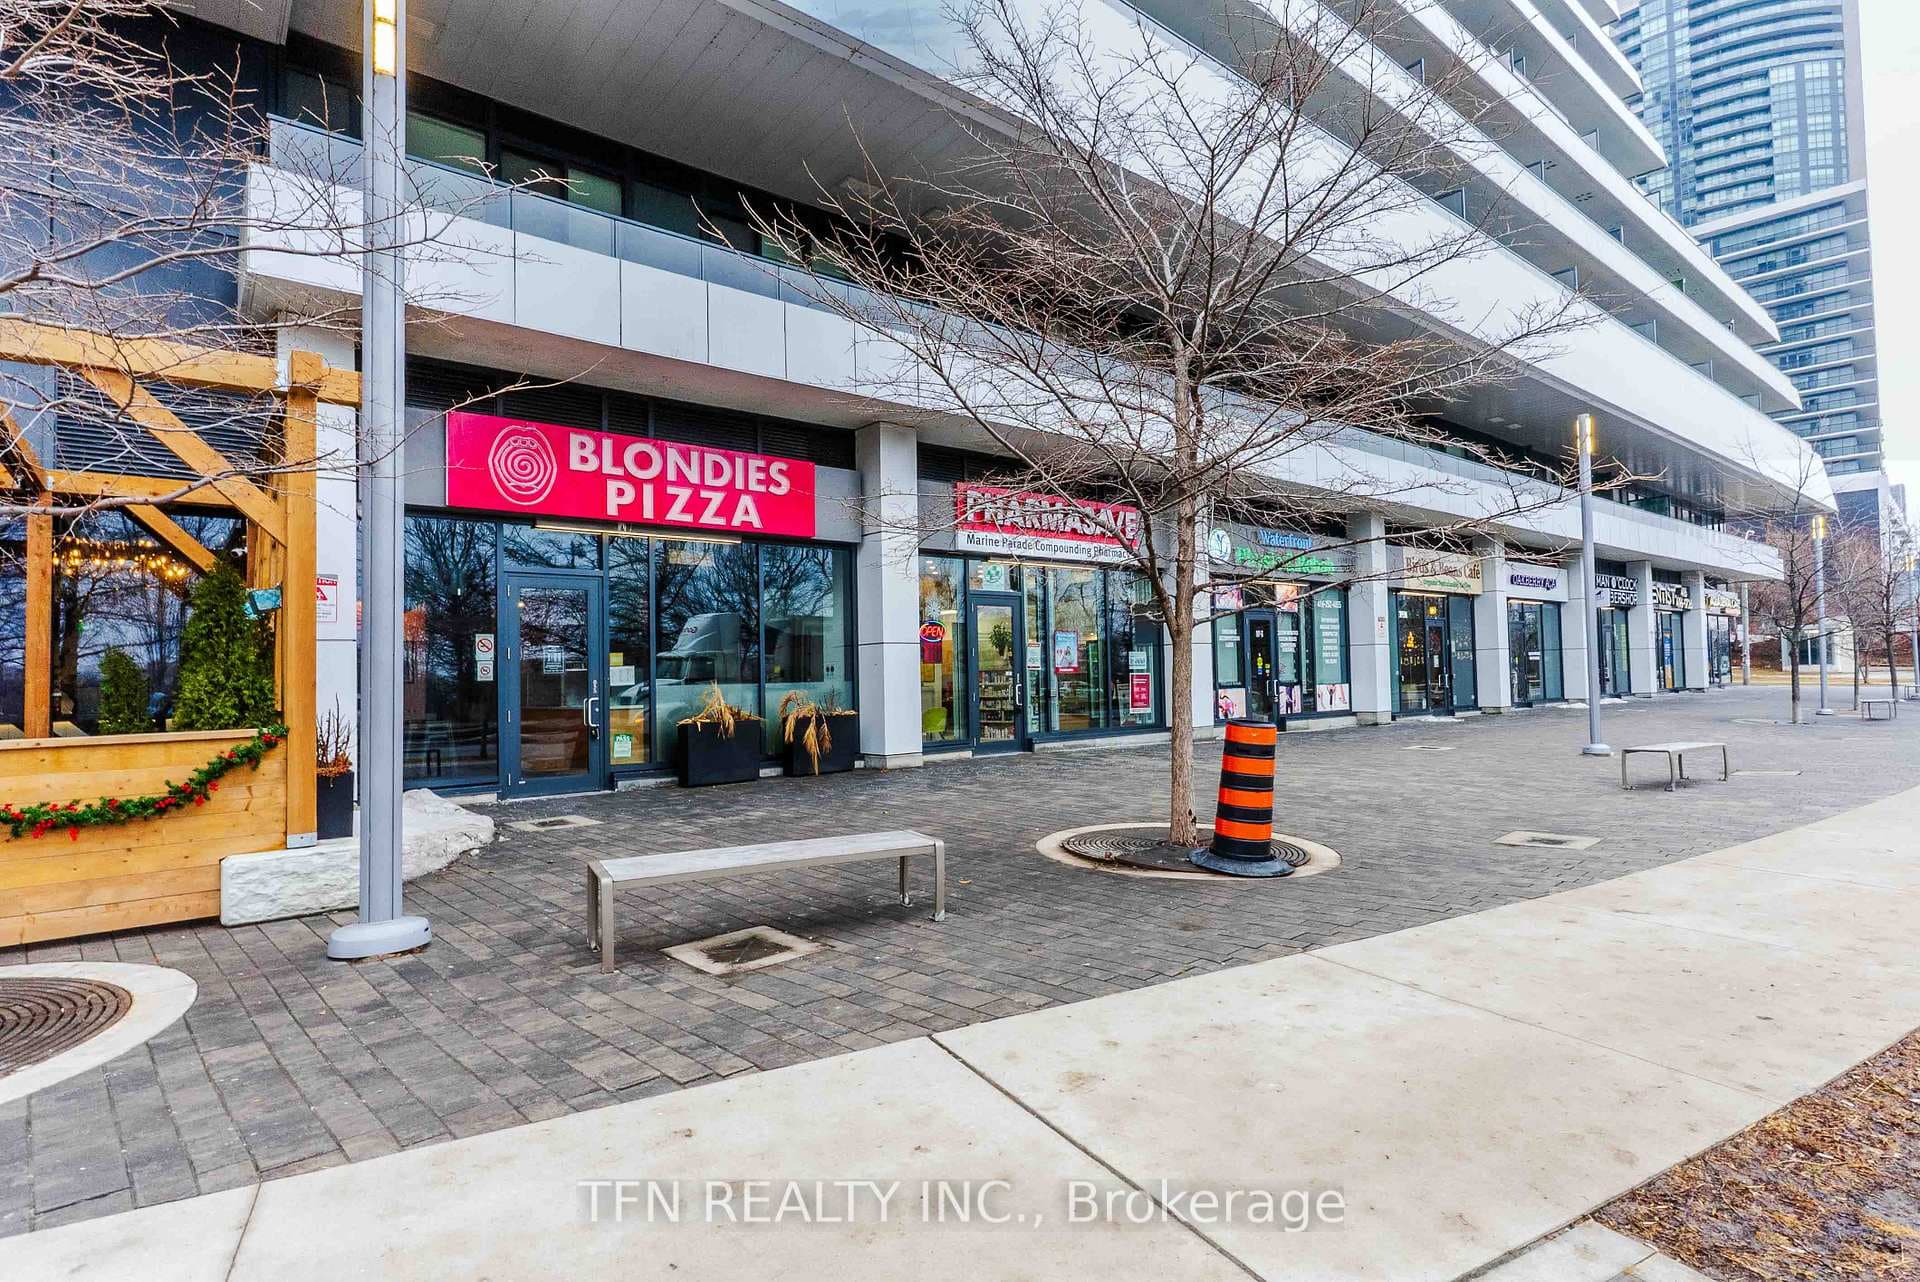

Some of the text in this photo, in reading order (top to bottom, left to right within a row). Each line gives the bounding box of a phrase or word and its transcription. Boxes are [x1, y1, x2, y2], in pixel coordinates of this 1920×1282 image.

[569, 432, 792, 497] BLONDIES
[605, 478, 764, 530] PIZZA
[966, 533, 1000, 547] Marine
[1001, 537, 1033, 550] Parade
[1034, 540, 1092, 558] Compounding
[1260, 529, 1313, 549] Waterfront
[1463, 563, 1481, 579] Café
[921, 626, 945, 640] OPEN
